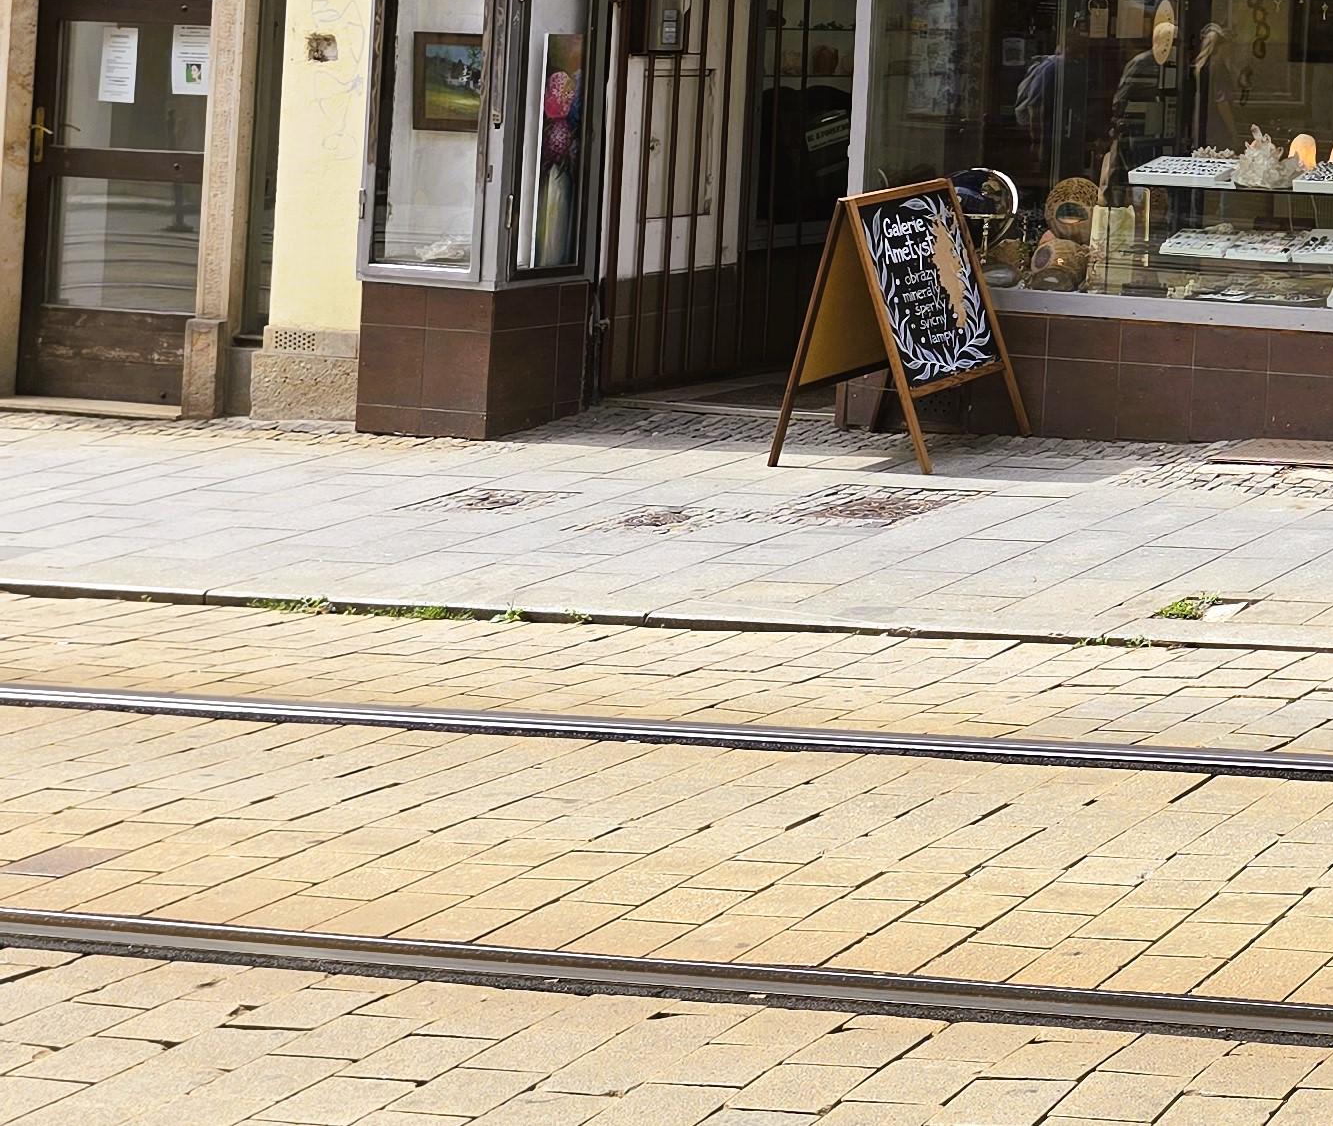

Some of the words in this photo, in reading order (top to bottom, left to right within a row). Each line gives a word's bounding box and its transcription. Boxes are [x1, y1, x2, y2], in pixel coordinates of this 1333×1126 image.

[882, 214, 926, 238] Galerie
[884, 230, 935, 270] Ametyst
[904, 267, 939, 287] obrazy
[927, 328, 956, 347] lampy
